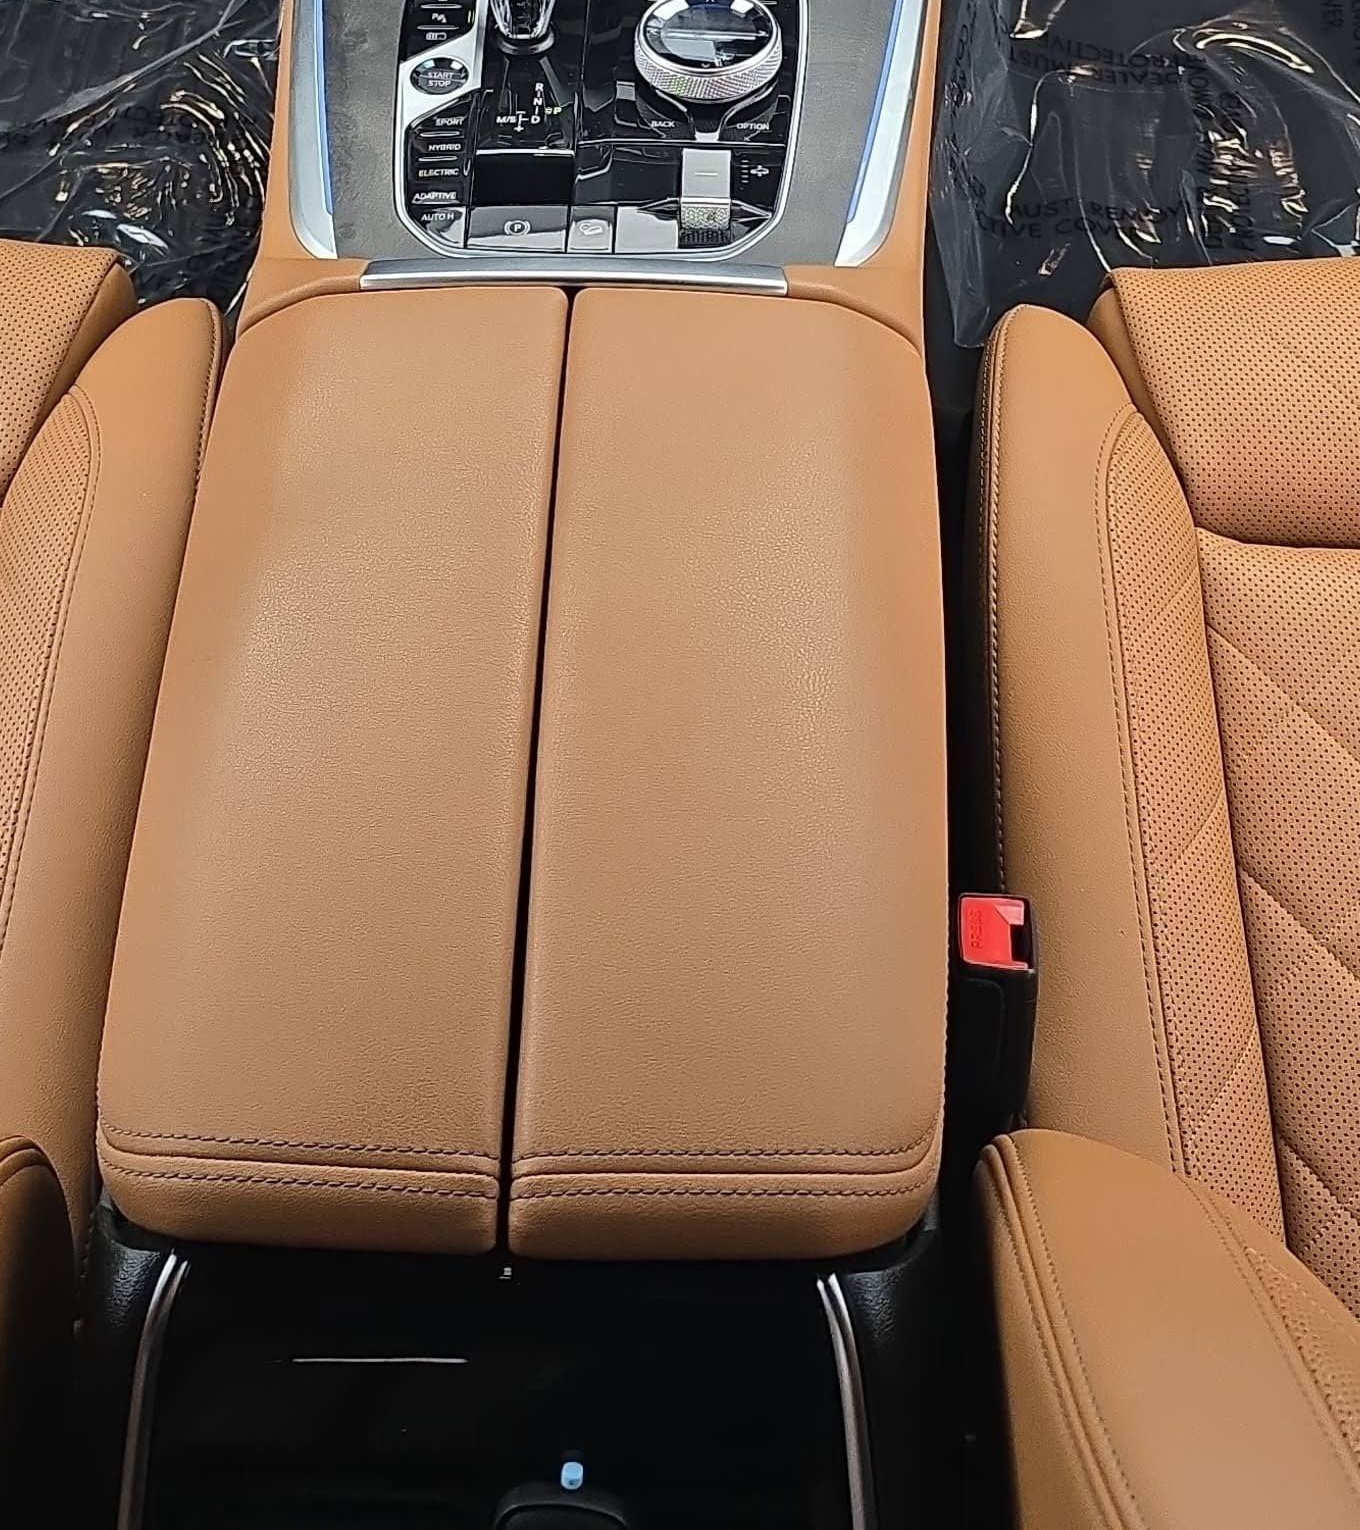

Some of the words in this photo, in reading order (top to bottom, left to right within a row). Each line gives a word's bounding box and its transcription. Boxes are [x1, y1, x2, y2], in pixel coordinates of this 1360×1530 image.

[427, 71, 455, 80] START
[427, 79, 451, 88] STOP
[435, 118, 465, 126] SPORT
[650, 120, 676, 128] BACK
[736, 122, 770, 130] OPTION
[428, 143, 462, 151] HYBRID
[418, 168, 460, 177] ELECTRIC
[413, 191, 458, 201] ADAPTIVE
[420, 212, 446, 222] AUTO
